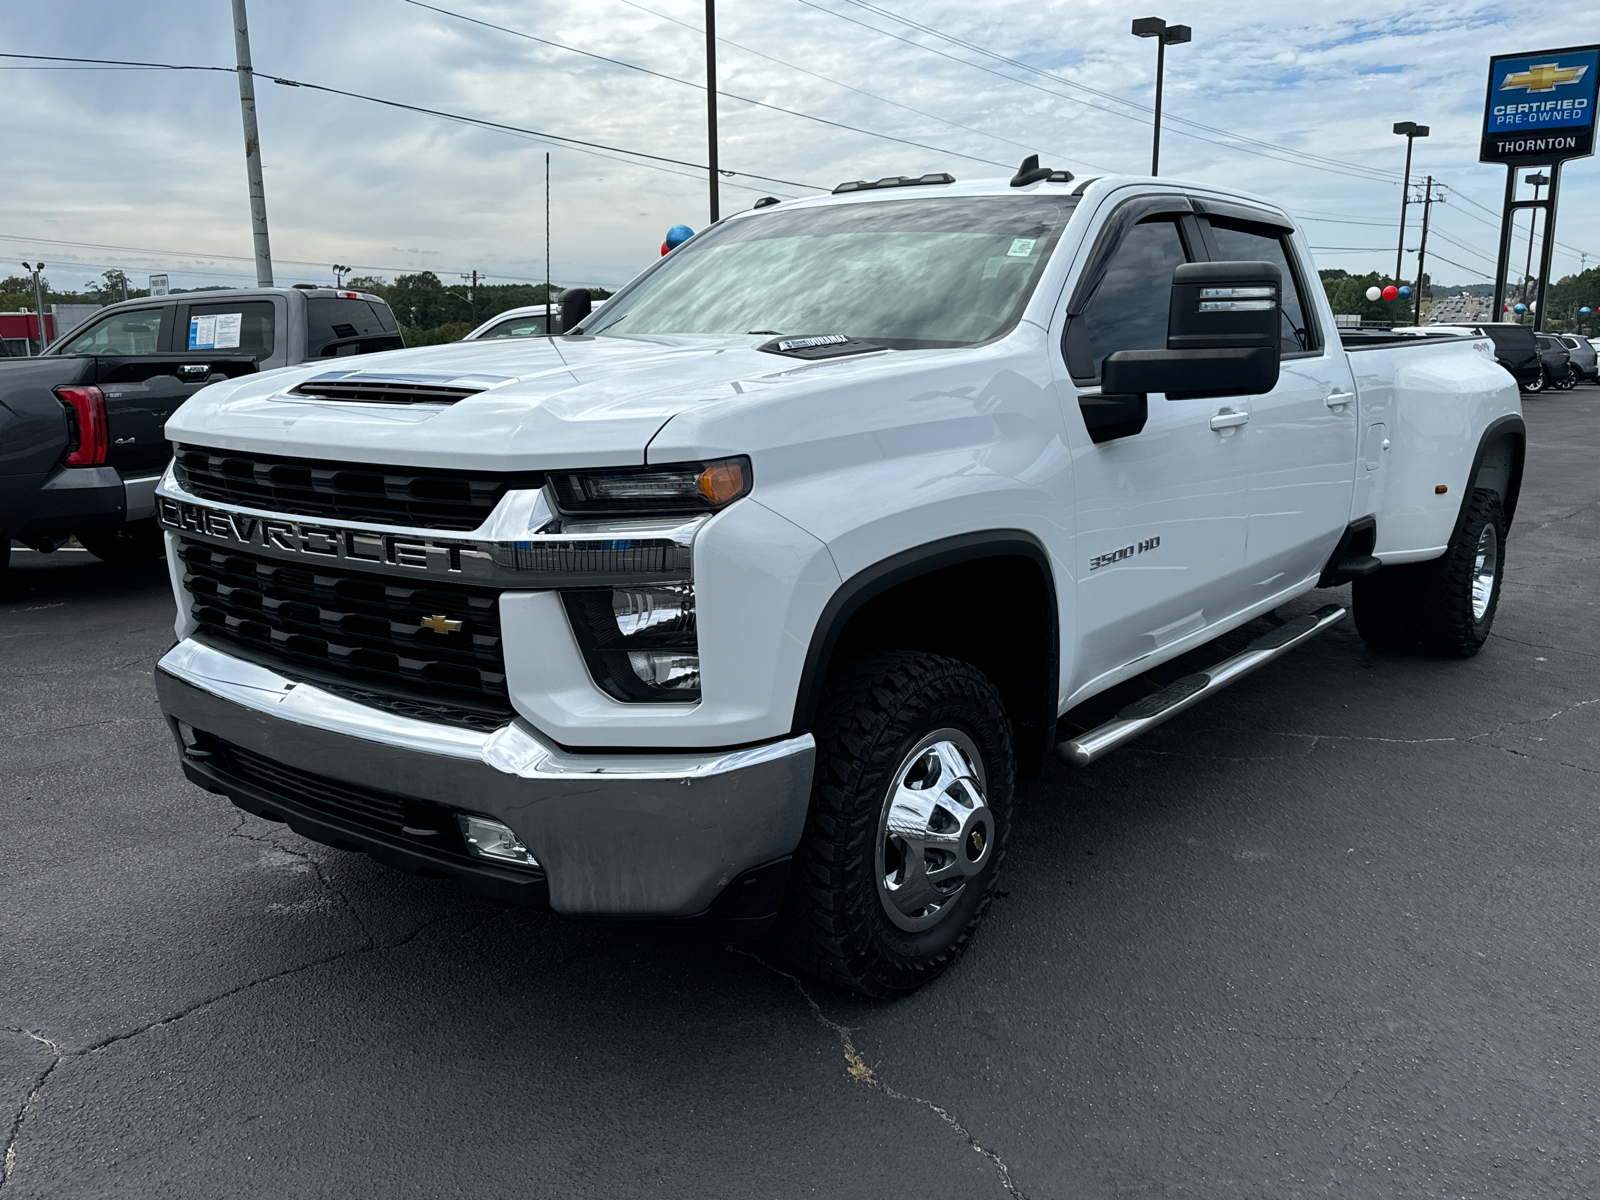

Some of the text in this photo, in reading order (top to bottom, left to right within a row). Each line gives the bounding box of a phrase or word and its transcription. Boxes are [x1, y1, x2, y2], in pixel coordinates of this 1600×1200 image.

[1493, 98, 1588, 116] CERTIFIED
[1496, 109, 1582, 125] PRE-OWNED
[1496, 136, 1576, 153] THORNTON
[808, 334, 849, 346] DURAMAX
[159, 499, 478, 573] CHEVROLET
[1089, 535, 1161, 572] 3500 HD
